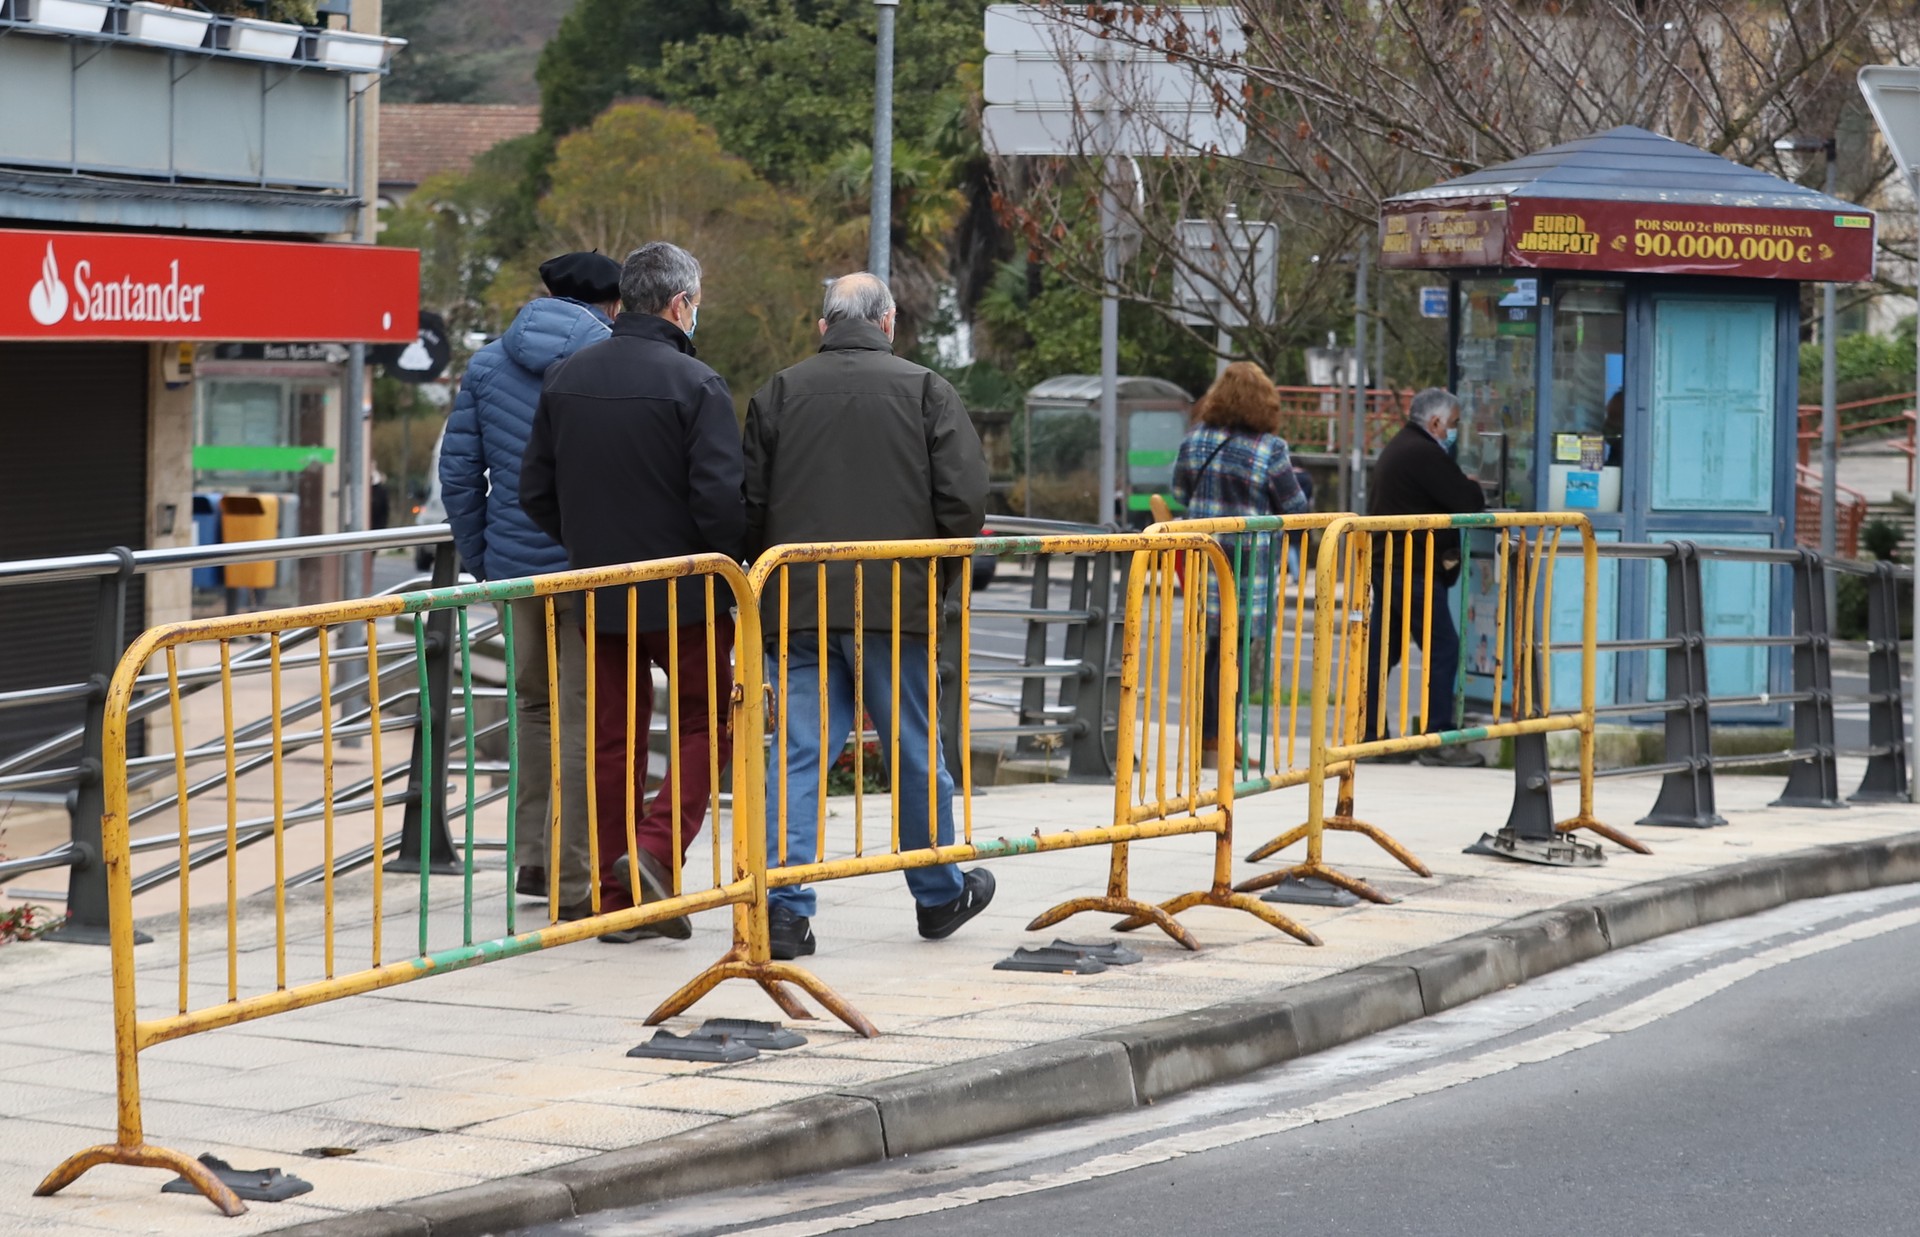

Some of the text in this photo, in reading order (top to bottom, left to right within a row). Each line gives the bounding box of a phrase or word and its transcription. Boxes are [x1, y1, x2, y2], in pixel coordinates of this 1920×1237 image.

[1533, 215, 1577, 233] EURO
[1635, 219, 1660, 231] POR
[1662, 220, 1695, 232] SOLO
[1713, 222, 1753, 235] BOTES
[1754, 224, 1771, 236] DE
[1772, 225, 1813, 238] HASTA
[1517, 233, 1595, 253] JACKPOT
[73, 259, 205, 322] Santander
